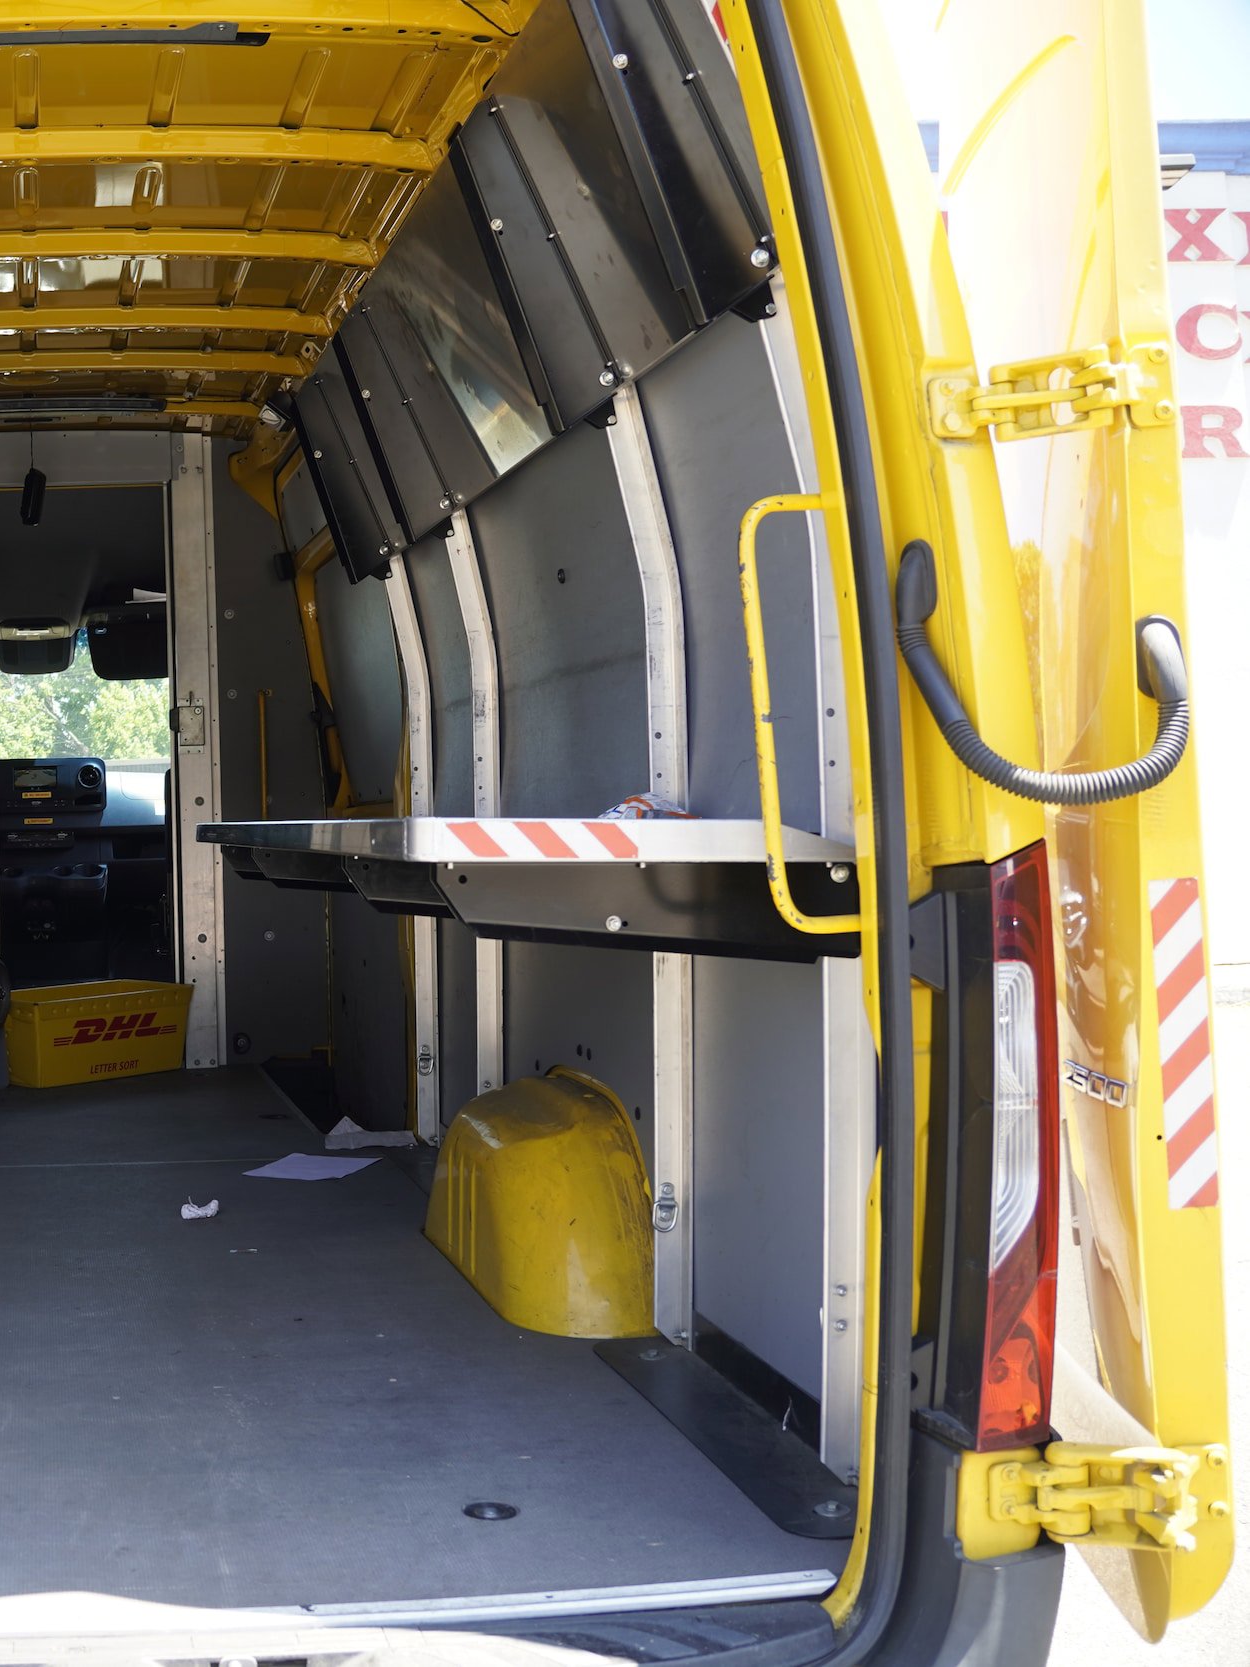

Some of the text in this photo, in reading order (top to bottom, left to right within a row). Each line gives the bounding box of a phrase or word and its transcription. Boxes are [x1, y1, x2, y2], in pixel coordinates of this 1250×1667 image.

[1176, 303, 1250, 362] C
[68, 1011, 164, 1045] DHL
[90, 1059, 139, 1075] LETTER SORT
